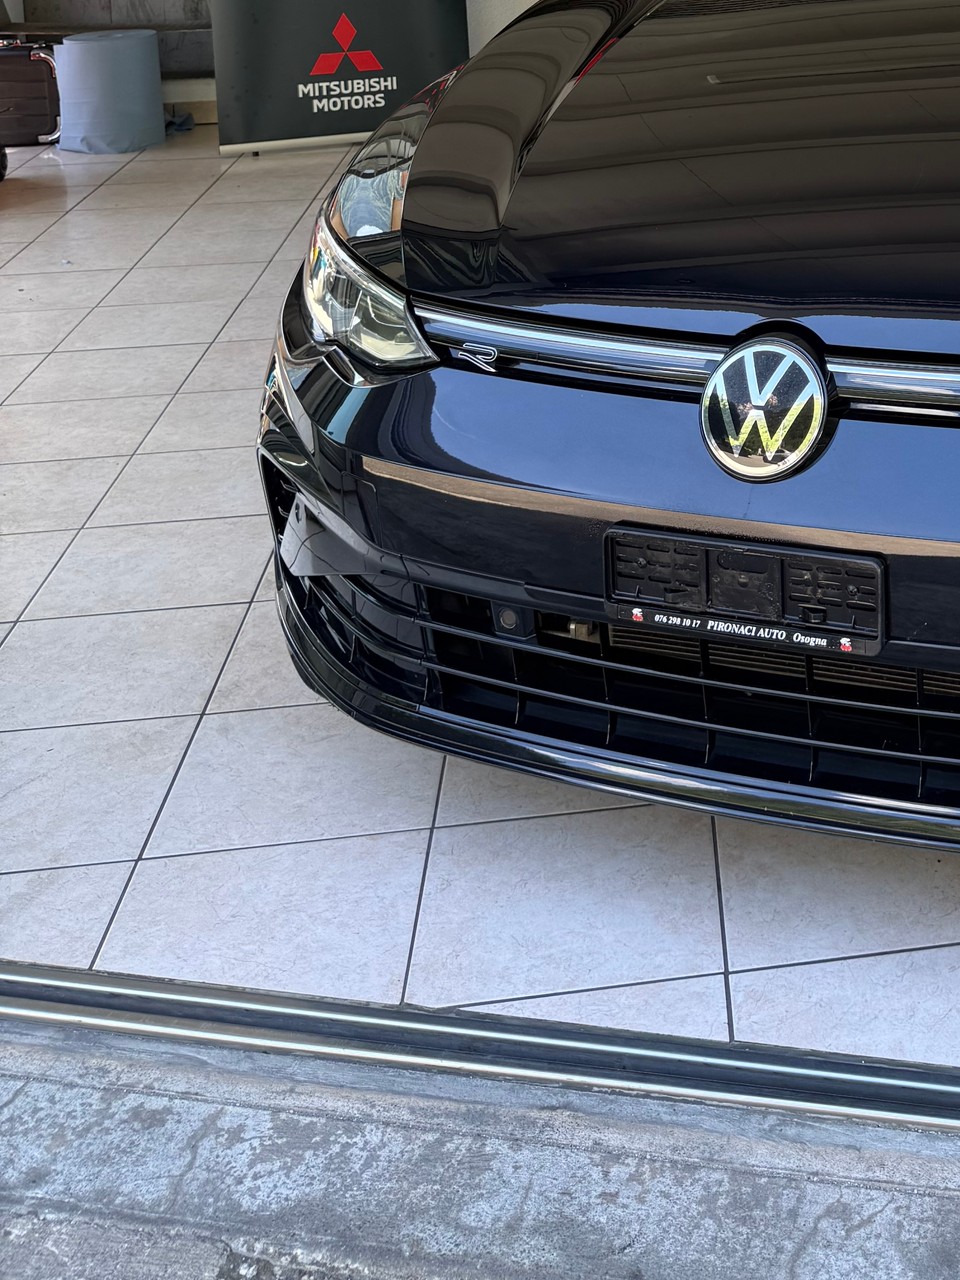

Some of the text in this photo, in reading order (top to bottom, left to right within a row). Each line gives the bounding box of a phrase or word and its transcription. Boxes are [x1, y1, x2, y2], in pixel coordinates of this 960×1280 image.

[297, 76, 398, 98] MITSUBISHI
[312, 93, 386, 113] MOTORS
[654, 614, 827, 647] 076 298 10 17 PIRONACI AUTO Osogna
